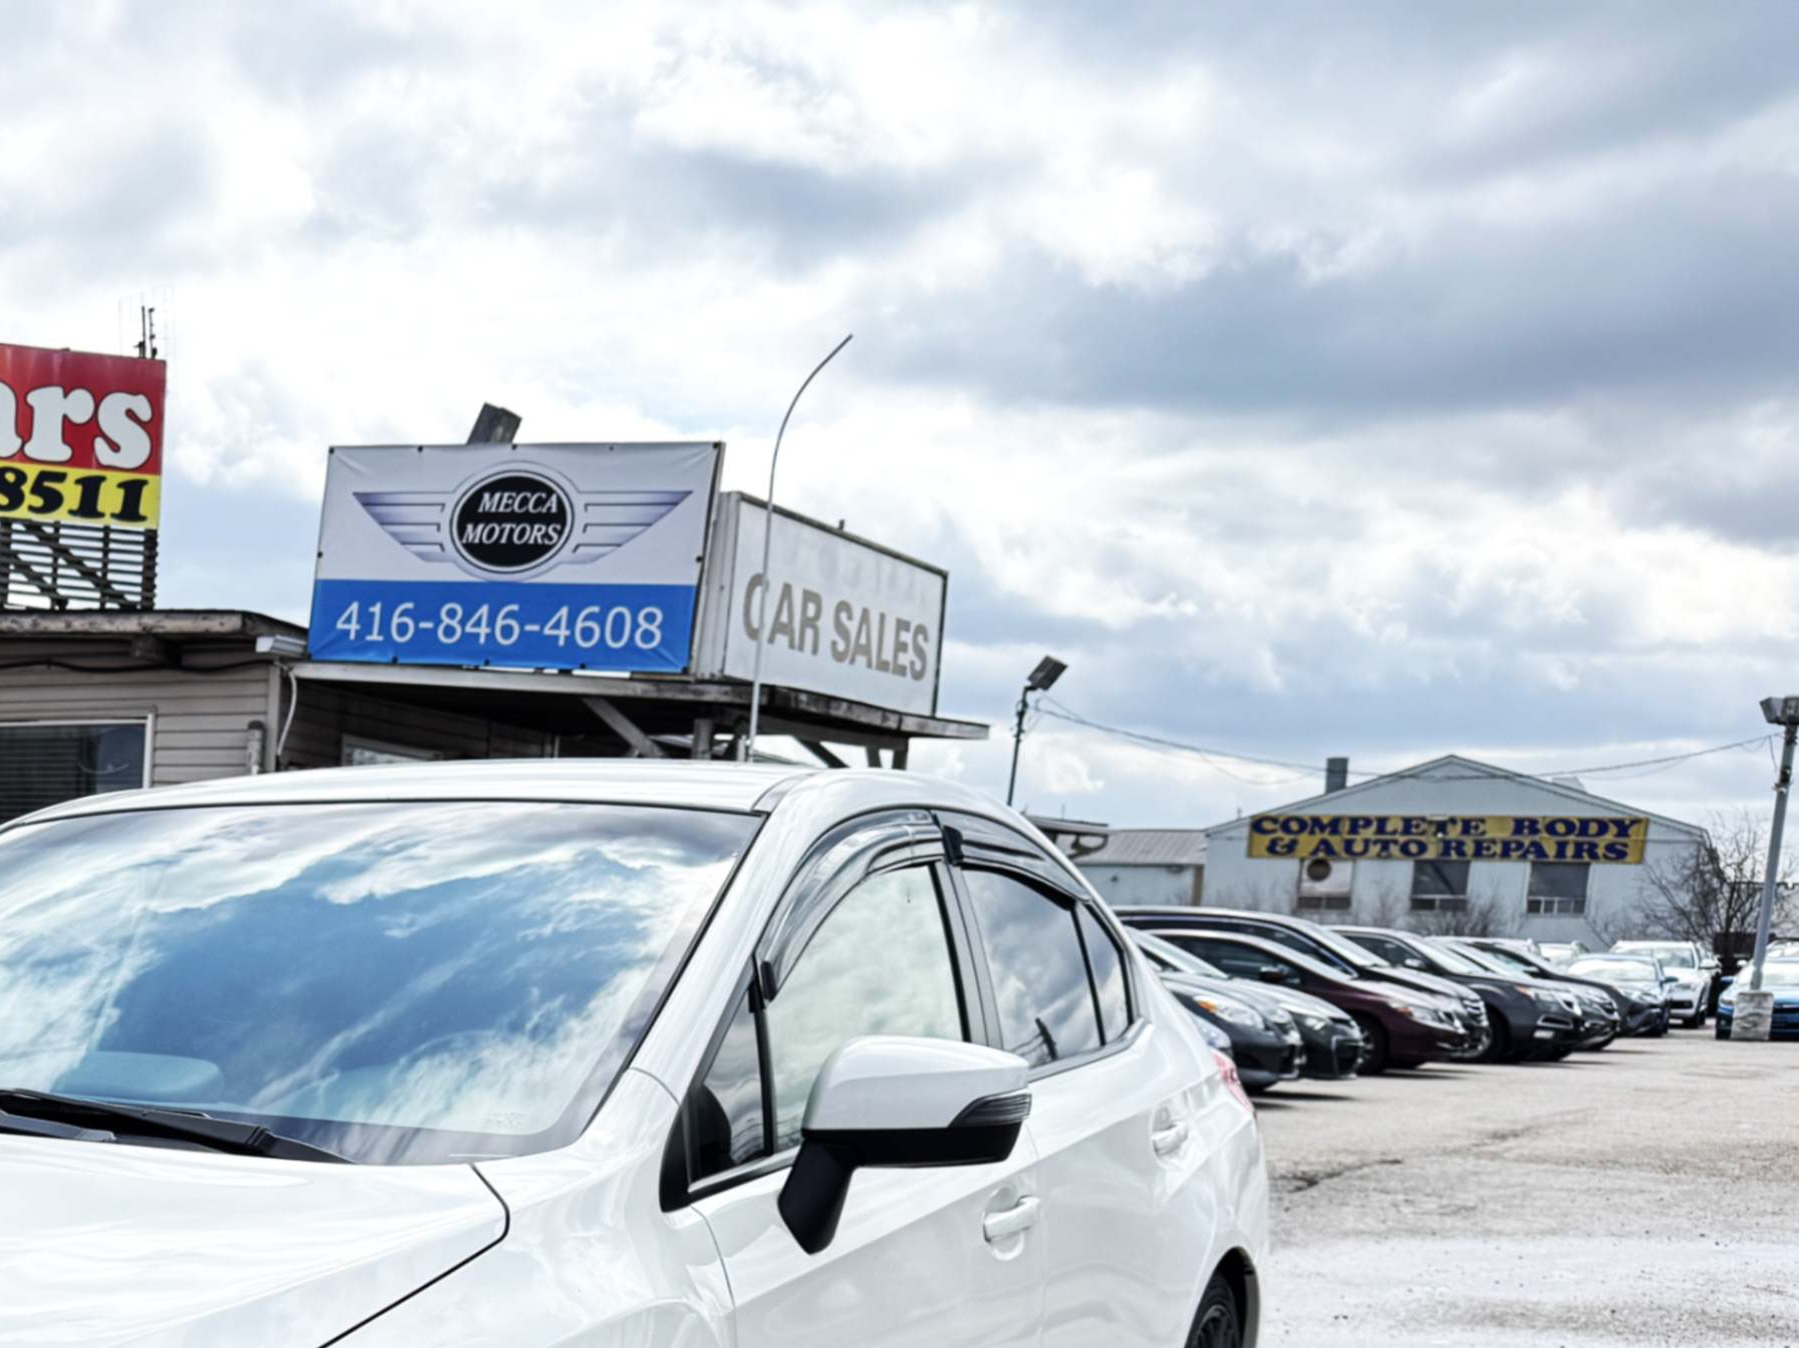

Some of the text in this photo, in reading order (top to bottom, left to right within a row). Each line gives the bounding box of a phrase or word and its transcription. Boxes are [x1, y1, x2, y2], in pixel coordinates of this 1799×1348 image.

[477, 490, 560, 515] MECCA
[461, 521, 564, 547] MOTORS
[335, 600, 665, 650] 416-846-4608
[743, 572, 930, 681] CAR SALES
[1252, 815, 1641, 839] COMPLETE BODY
[1265, 837, 1630, 862] & AUTO REPAIRS
